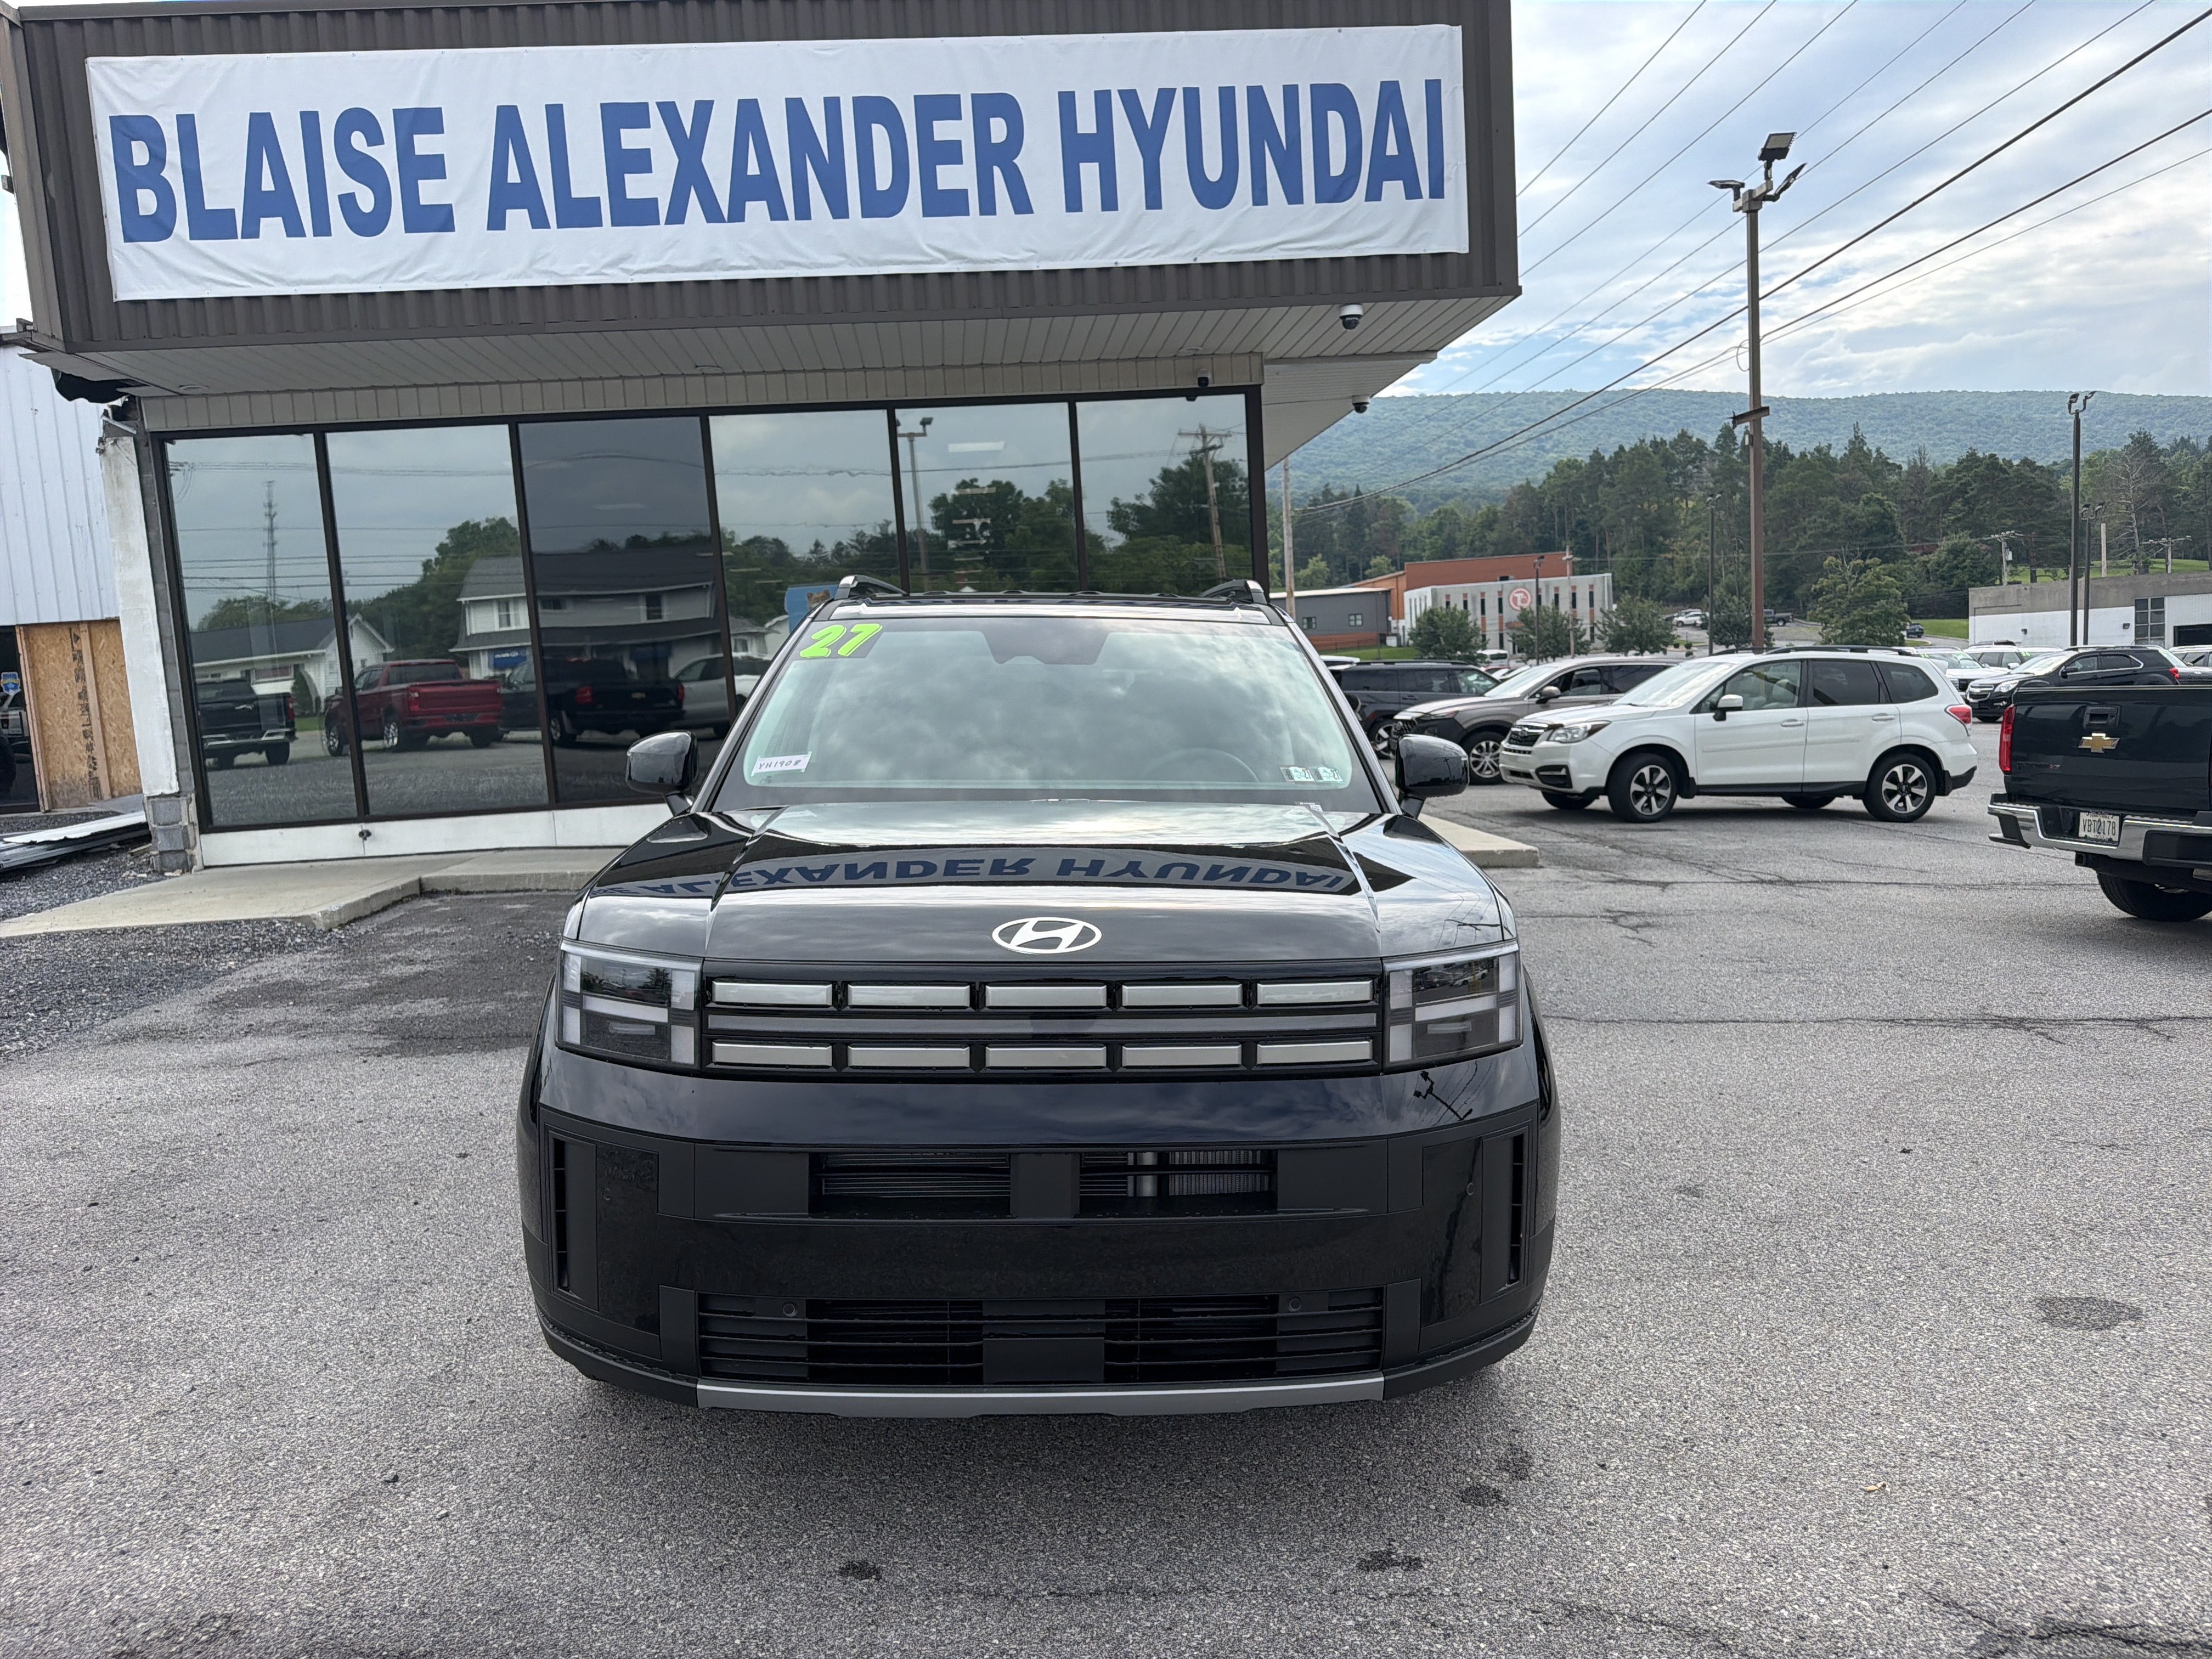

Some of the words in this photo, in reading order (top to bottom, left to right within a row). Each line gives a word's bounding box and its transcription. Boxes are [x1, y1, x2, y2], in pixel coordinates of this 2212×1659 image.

[109, 108, 455, 242] BLAISE
[487, 93, 1034, 230] ALEXANDER
[1058, 80, 1444, 212] HYUNDAI
[800, 623, 883, 658] 27
